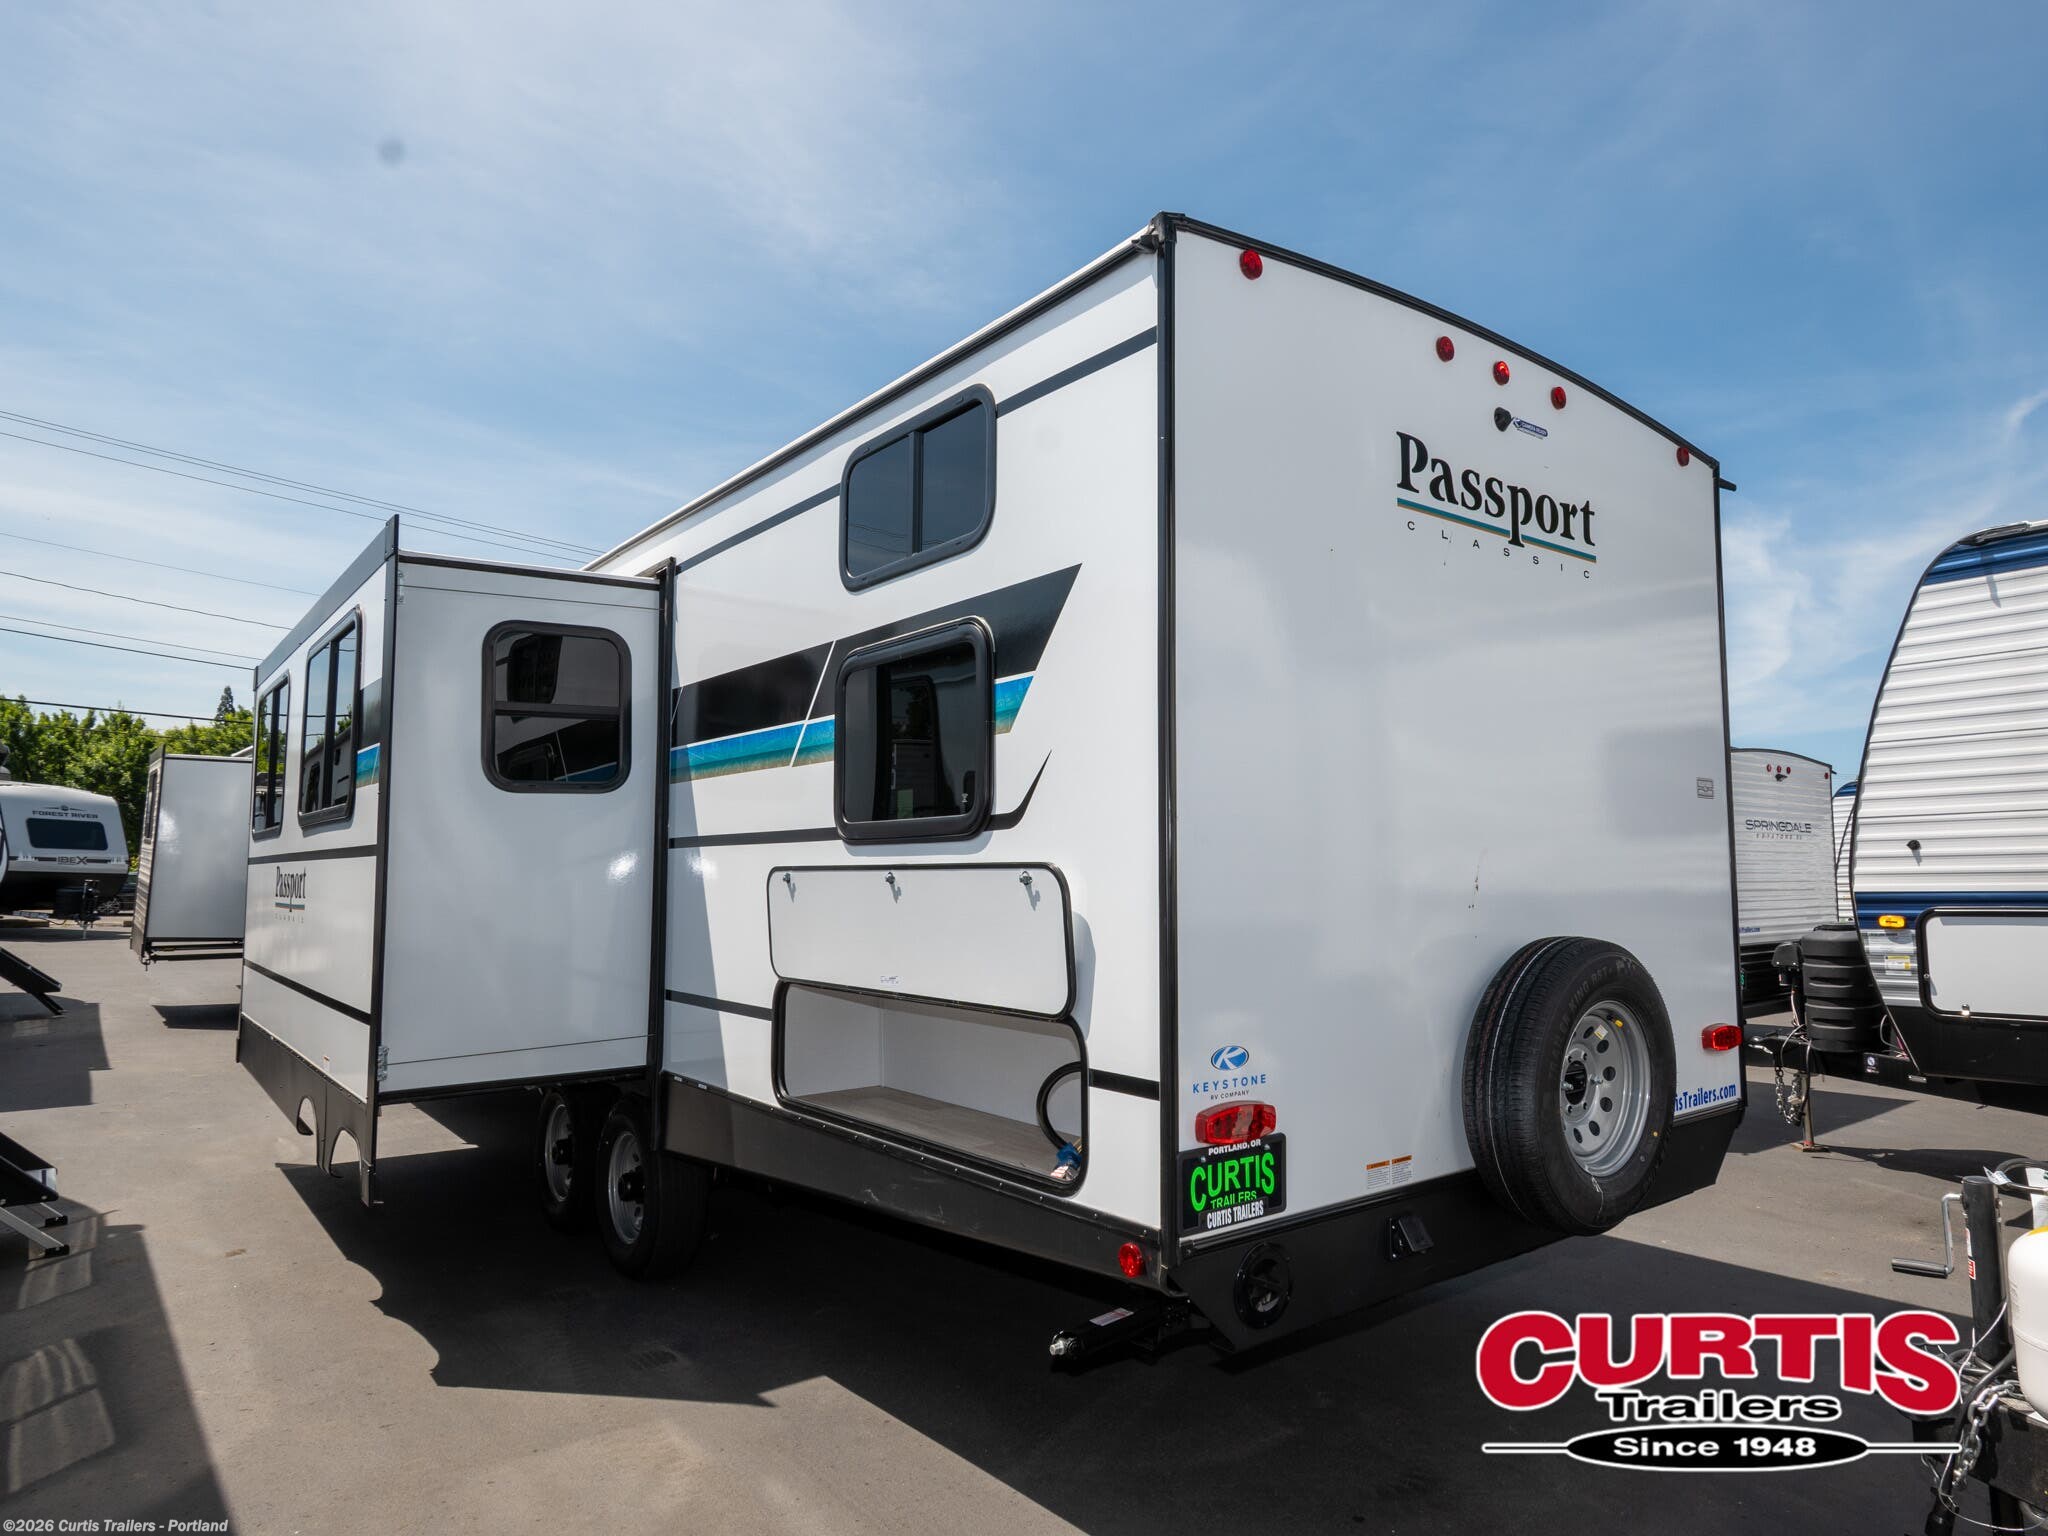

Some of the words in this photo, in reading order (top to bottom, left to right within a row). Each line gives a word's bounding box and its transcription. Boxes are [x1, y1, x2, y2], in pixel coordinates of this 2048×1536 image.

[1396, 431, 1596, 548] Passport
[1406, 521, 1590, 579] CLASSIC
[1745, 819, 1812, 833] SPRINGDALE
[57, 856, 88, 865] IBEX
[275, 866, 306, 912] Passport
[1192, 1074, 1267, 1094] KEYSTONE
[1220, 1090, 1250, 1099] COMPANY
[1674, 1084, 1737, 1111] isTrailers.com
[1208, 1142, 1250, 1156] PORTLAND,
[1250, 1138, 1262, 1148] OR
[1190, 1152, 1275, 1212] CURTIS
[1207, 1208, 1232, 1229] CURTIS
[1233, 1200, 1264, 1222] TRAILERS
